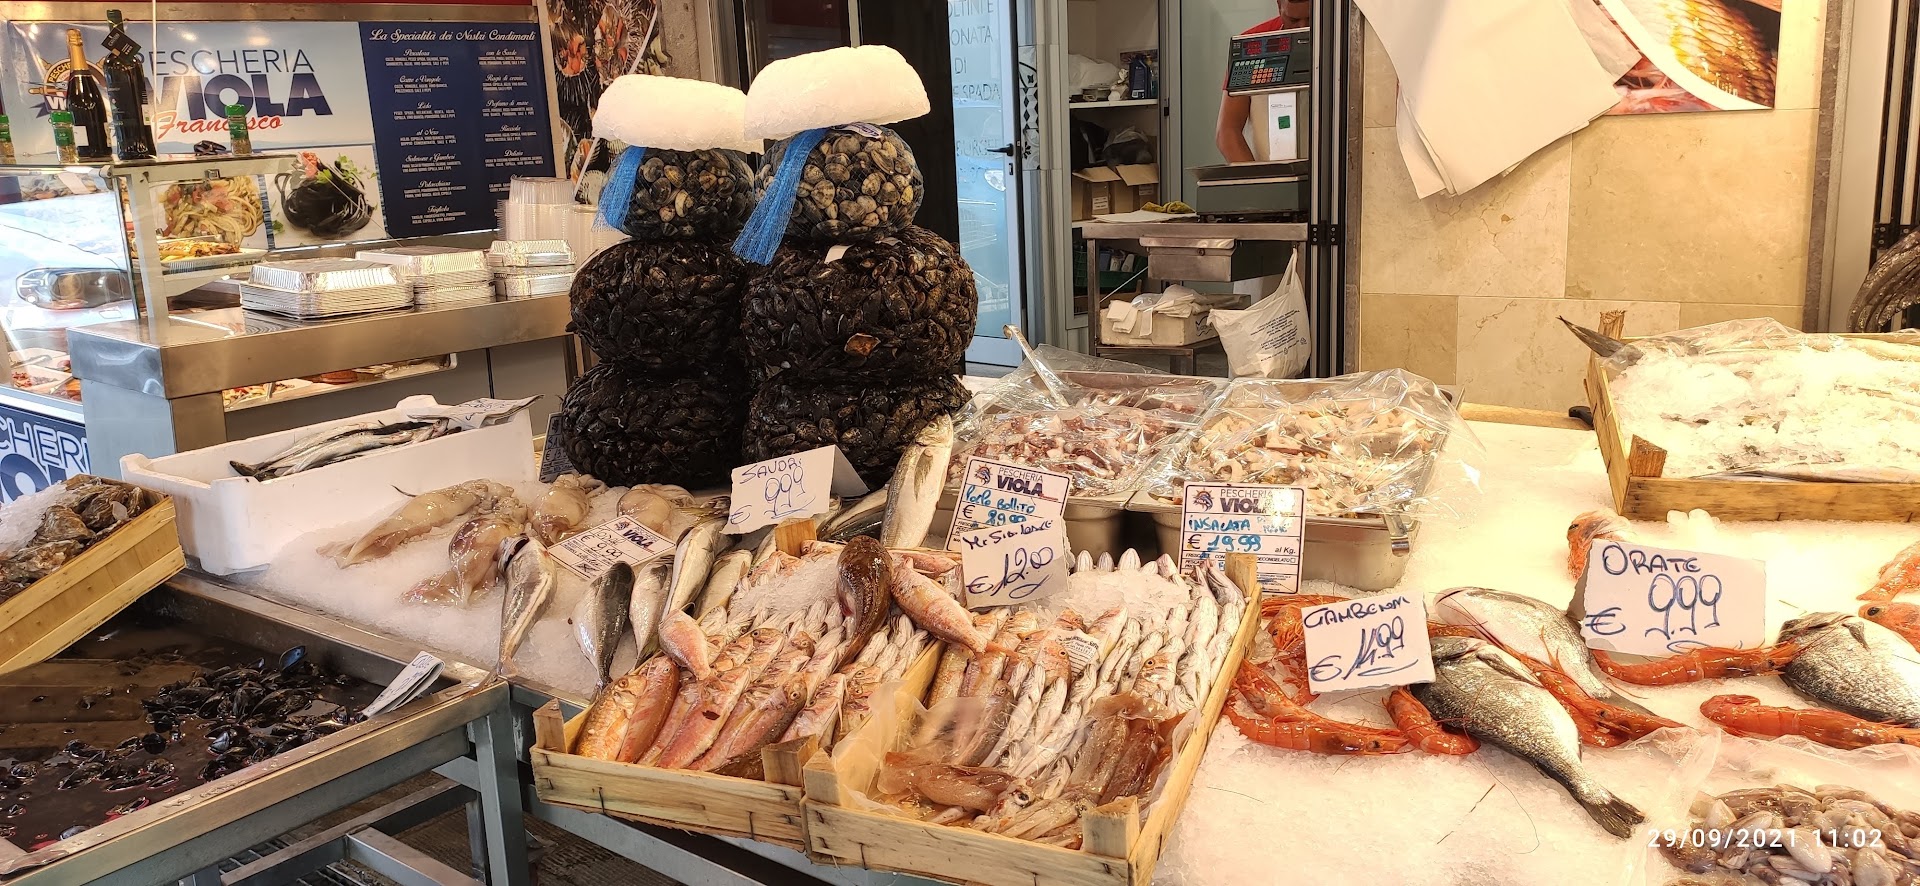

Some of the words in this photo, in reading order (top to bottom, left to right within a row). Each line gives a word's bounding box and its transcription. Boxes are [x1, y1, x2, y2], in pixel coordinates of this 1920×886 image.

[369, 29, 388, 40] La
[390, 29, 436, 43] Specialità
[439, 31, 453, 41] dei
[456, 30, 487, 41] Nostri
[488, 29, 536, 41] Condimenti
[954, 56, 967, 75] DI
[153, 111, 284, 139] Francsco
[998, 467, 1044, 483] PESCHERIA
[997, 475, 1044, 497] VIOLA
[730, 505, 752, 525] €
[962, 504, 976, 518] €
[623, 529, 654, 550] VIOLA
[1187, 534, 1202, 550] €
[1602, 542, 1701, 576] ORATE
[1585, 607, 1626, 635] €
